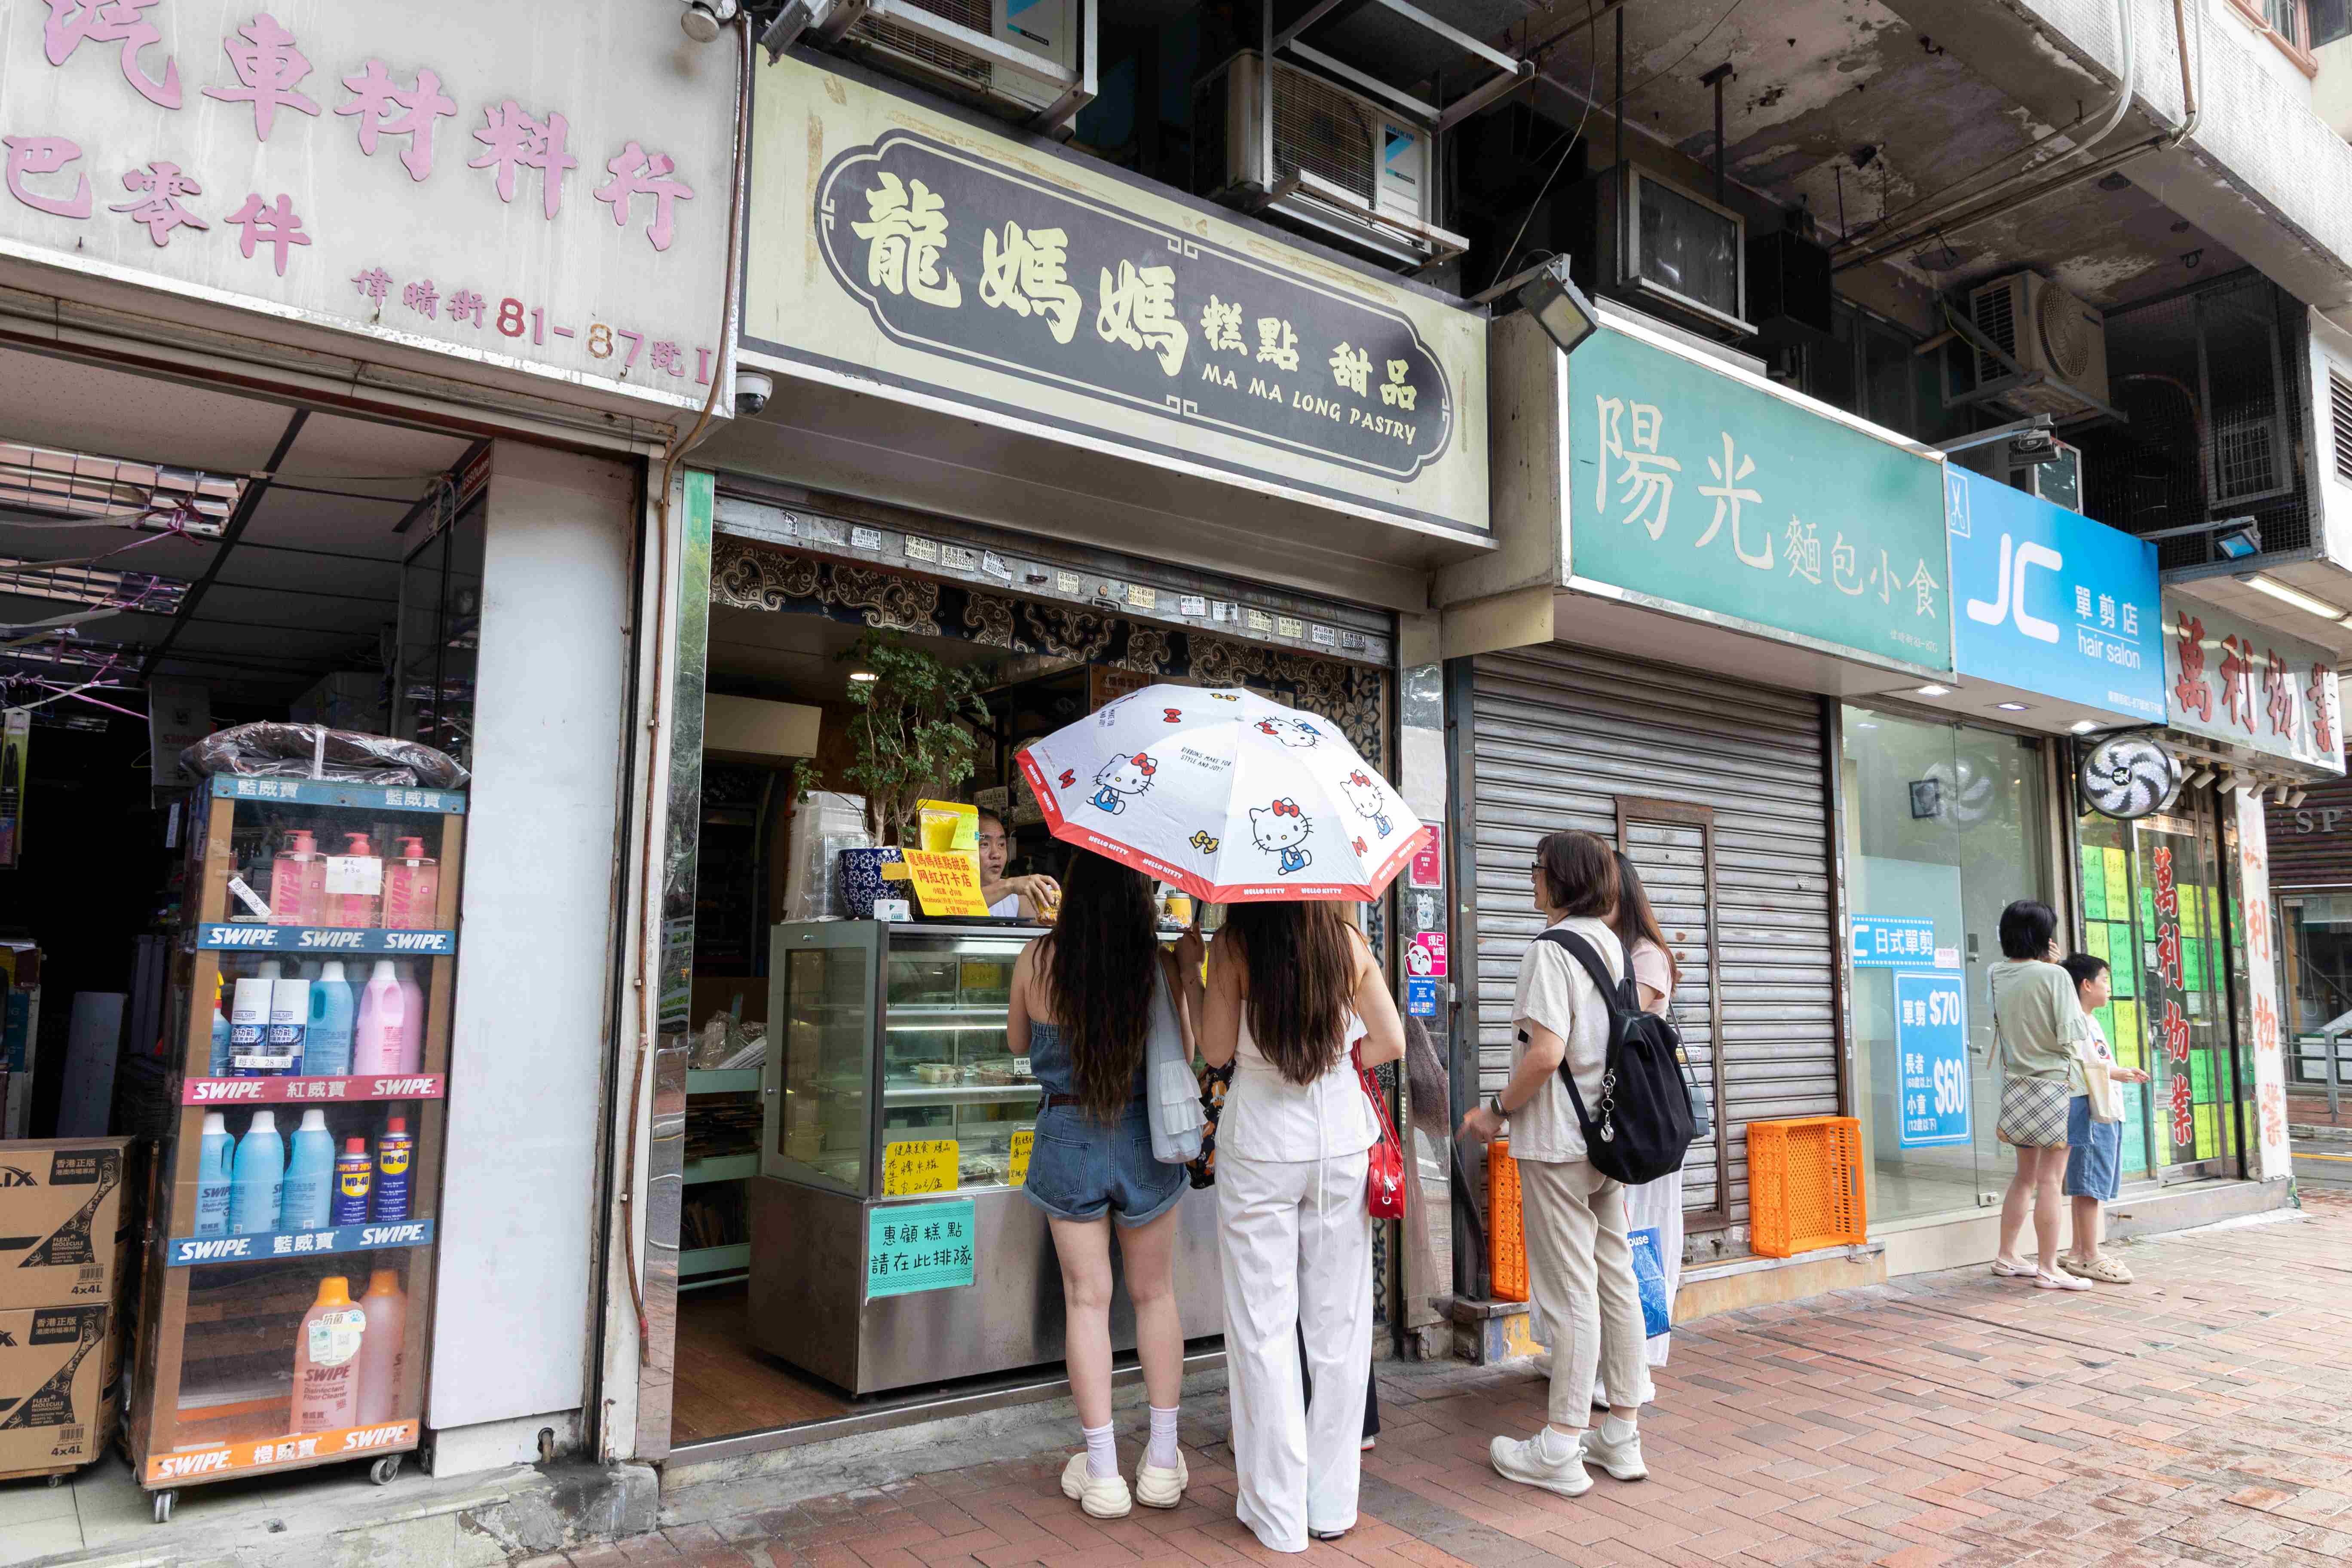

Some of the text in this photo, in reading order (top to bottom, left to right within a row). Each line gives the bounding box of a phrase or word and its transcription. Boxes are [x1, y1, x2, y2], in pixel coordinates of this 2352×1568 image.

[851, 172, 1417, 411] 龍媽媽 糕點 甜品
[1202, 363, 1417, 445] MA MA LONG PASTRY
[1596, 394, 1774, 570] 陽光
[1967, 533, 2062, 644] JC
[2074, 585, 2139, 638] 單剪店
[2077, 628, 2141, 671] hair salon
[2174, 610, 2335, 753] 萬利物業
[1181, 747, 1204, 758] RIBBONS
[1181, 754, 1197, 764] STYLE
[237, 780, 299, 798] 藍威寶
[385, 789, 441, 808] 藍威寶
[1088, 835, 1129, 855] HELLO KITTY
[1143, 858, 1183, 879] HELLO KITTY
[208, 928, 277, 946] SWIPE
[298, 931, 363, 947] SWIPE
[384, 933, 445, 949] SWIPE
[1875, 928, 1933, 956] 日式單剪
[2153, 845, 2192, 1147] 萬利物業
[1902, 989, 1960, 1027] 單剪 $70
[193, 1081, 263, 1099] SWIPE
[286, 1081, 346, 1097] 紅威寶
[371, 1078, 434, 1095] SWIPE
[1905, 1053, 1964, 1117] 長者 $60
[1907, 1093, 1926, 1115] 小童
[56, 1158, 97, 1168] 香港正版
[383, 1155, 407, 1164] WD-40
[0, 1168, 37, 1188] IX
[345, 1176, 368, 1187] WD-40
[273, 1232, 334, 1254] 藍威寶
[360, 1224, 423, 1245] SWIPE
[882, 1222, 962, 1246] 惠顧糕點
[1628, 1235, 1649, 1247] ouse
[178, 1238, 249, 1261] SWIPE
[871, 1245, 973, 1275] 請在此排隊
[71, 1285, 102, 1294] 4x4L
[37, 1317, 77, 1328] 香港正版
[304, 1365, 351, 1382] SWIPE
[343, 1425, 407, 1450] SWIPE
[51, 1445, 83, 1456] 4x4L
[158, 1450, 230, 1478] SWIPE
